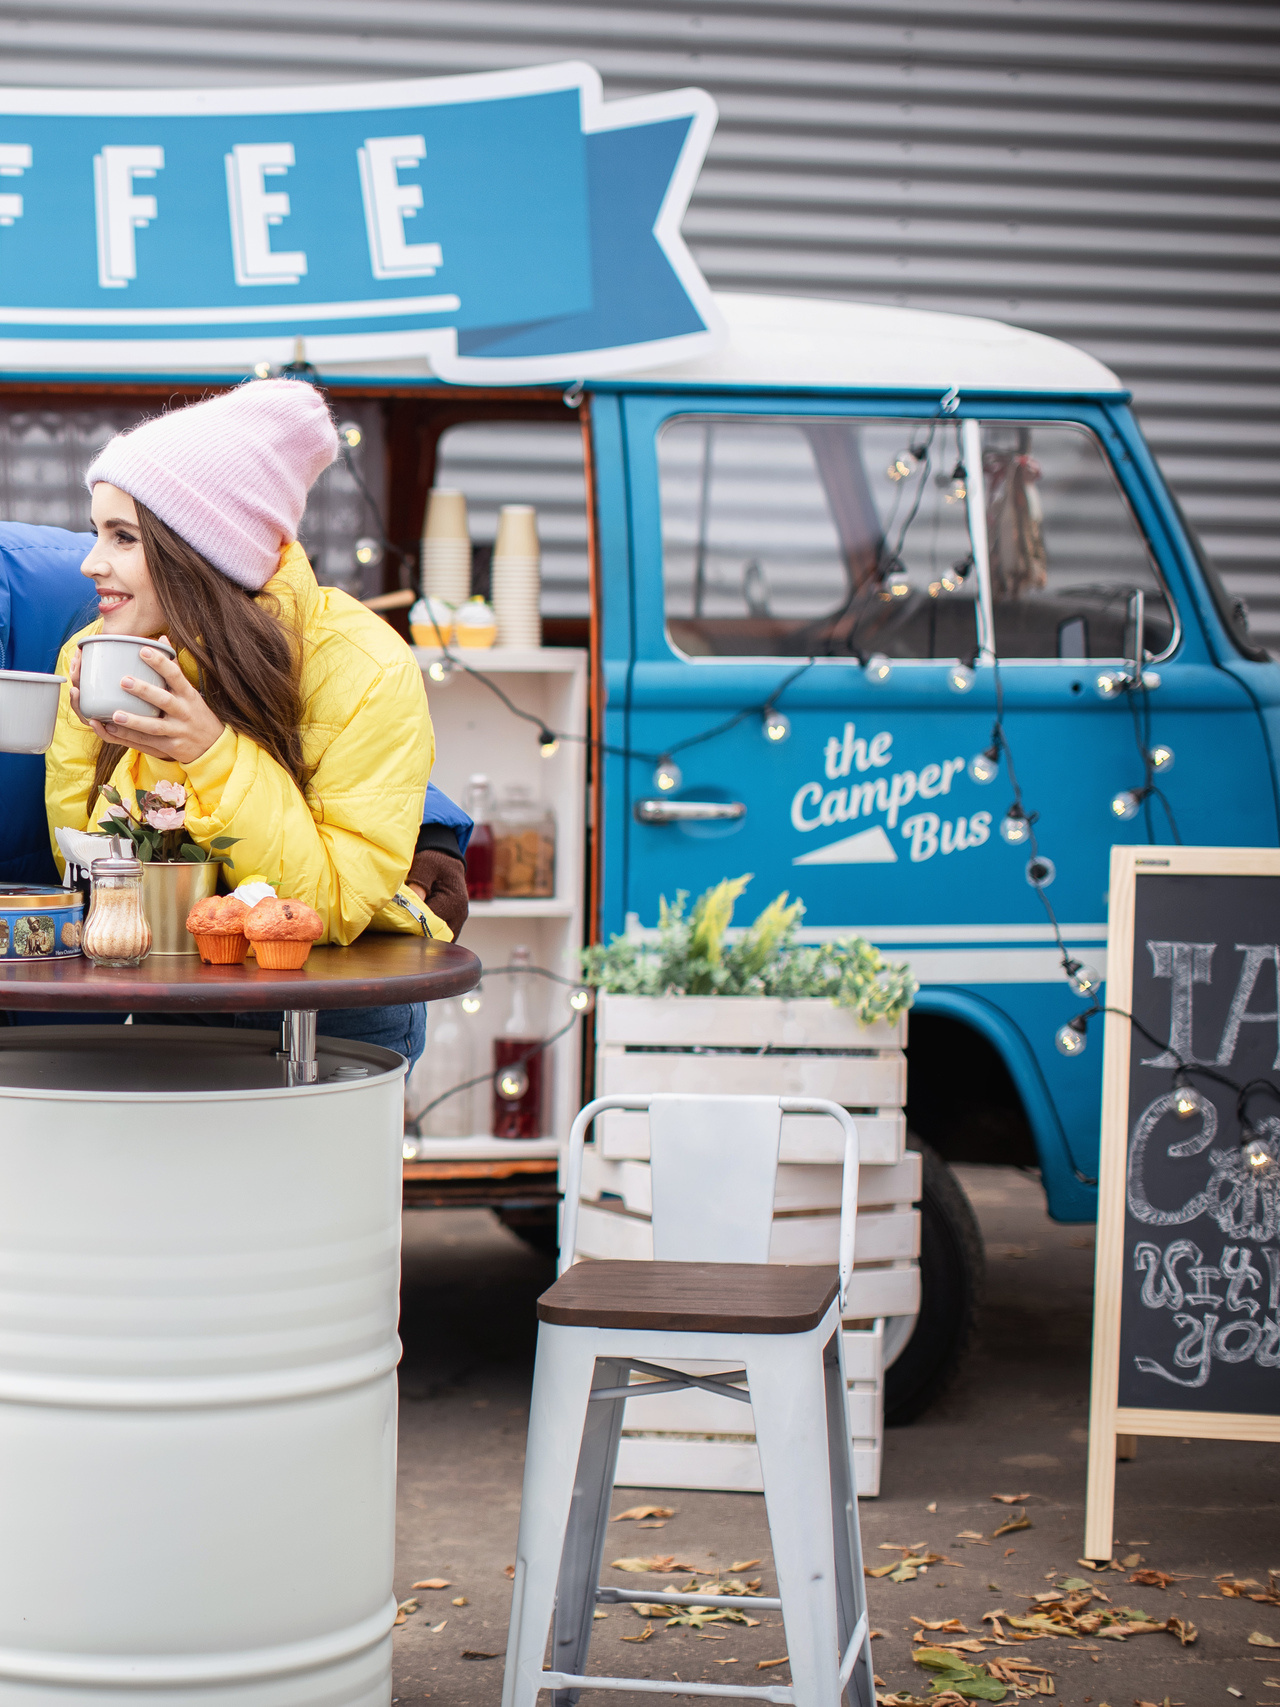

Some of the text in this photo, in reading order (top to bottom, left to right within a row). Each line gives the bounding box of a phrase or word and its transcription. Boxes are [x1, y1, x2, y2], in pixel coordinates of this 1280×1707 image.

[824, 721, 893, 780] the
[790, 756, 966, 833] Camper
[901, 811, 992, 863] Bus
